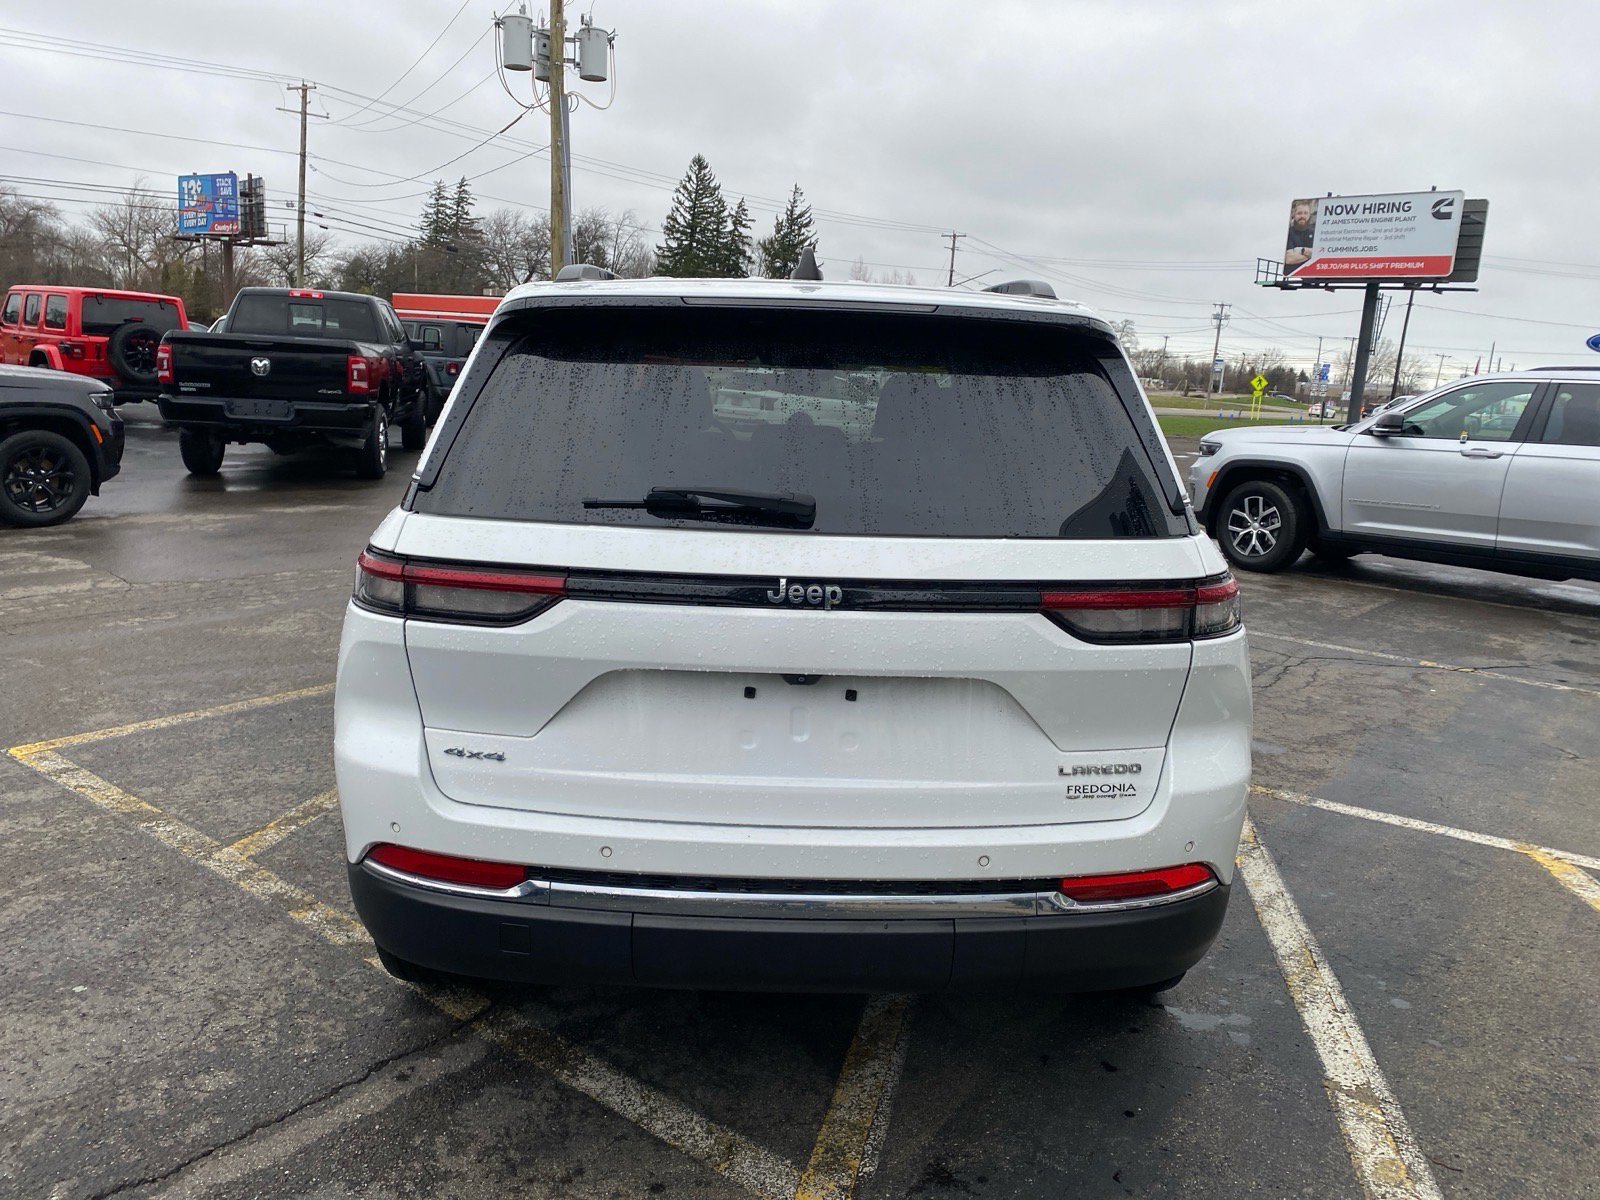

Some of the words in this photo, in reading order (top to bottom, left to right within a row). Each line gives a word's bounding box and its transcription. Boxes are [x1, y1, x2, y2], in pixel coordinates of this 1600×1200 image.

[216, 178, 232, 187] STACK
[220, 187, 232, 195] SAVE
[1324, 204, 1360, 216] NOW
[1362, 201, 1412, 215] HIRING
[183, 211, 197, 219] EVERY
[183, 219, 197, 228] EVERY
[197, 218, 207, 226] DAY
[1331, 217, 1370, 225] JAMESTOWN
[1350, 262, 1368, 270] PLUS
[1390, 261, 1424, 269] PREMIUM
[766, 578, 843, 611] Jeep
[1058, 763, 1142, 776] LAREDO
[1066, 783, 1137, 794] FREDONIA
